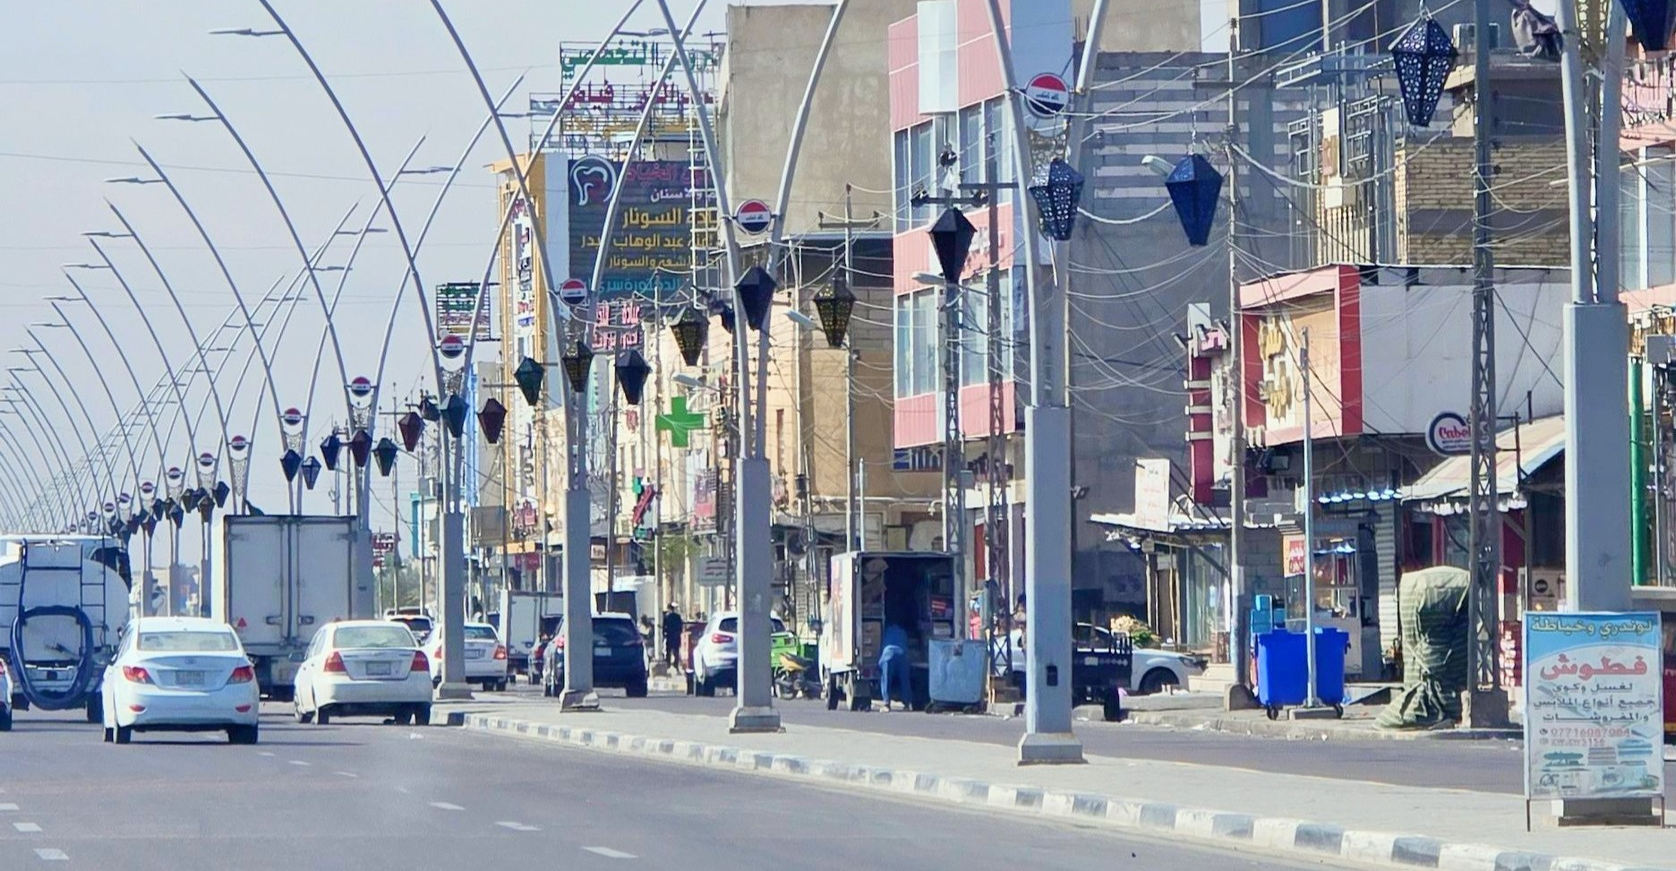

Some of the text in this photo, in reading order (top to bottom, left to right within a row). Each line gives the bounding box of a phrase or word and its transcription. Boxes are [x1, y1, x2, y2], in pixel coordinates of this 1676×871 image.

[622, 206, 682, 229] السونار
[613, 233, 660, 250] الوهاب
[663, 236, 684, 249] عبد
[1531, 616, 1653, 639] لوندري وخياطة
[1540, 653, 1648, 681] فطوش
